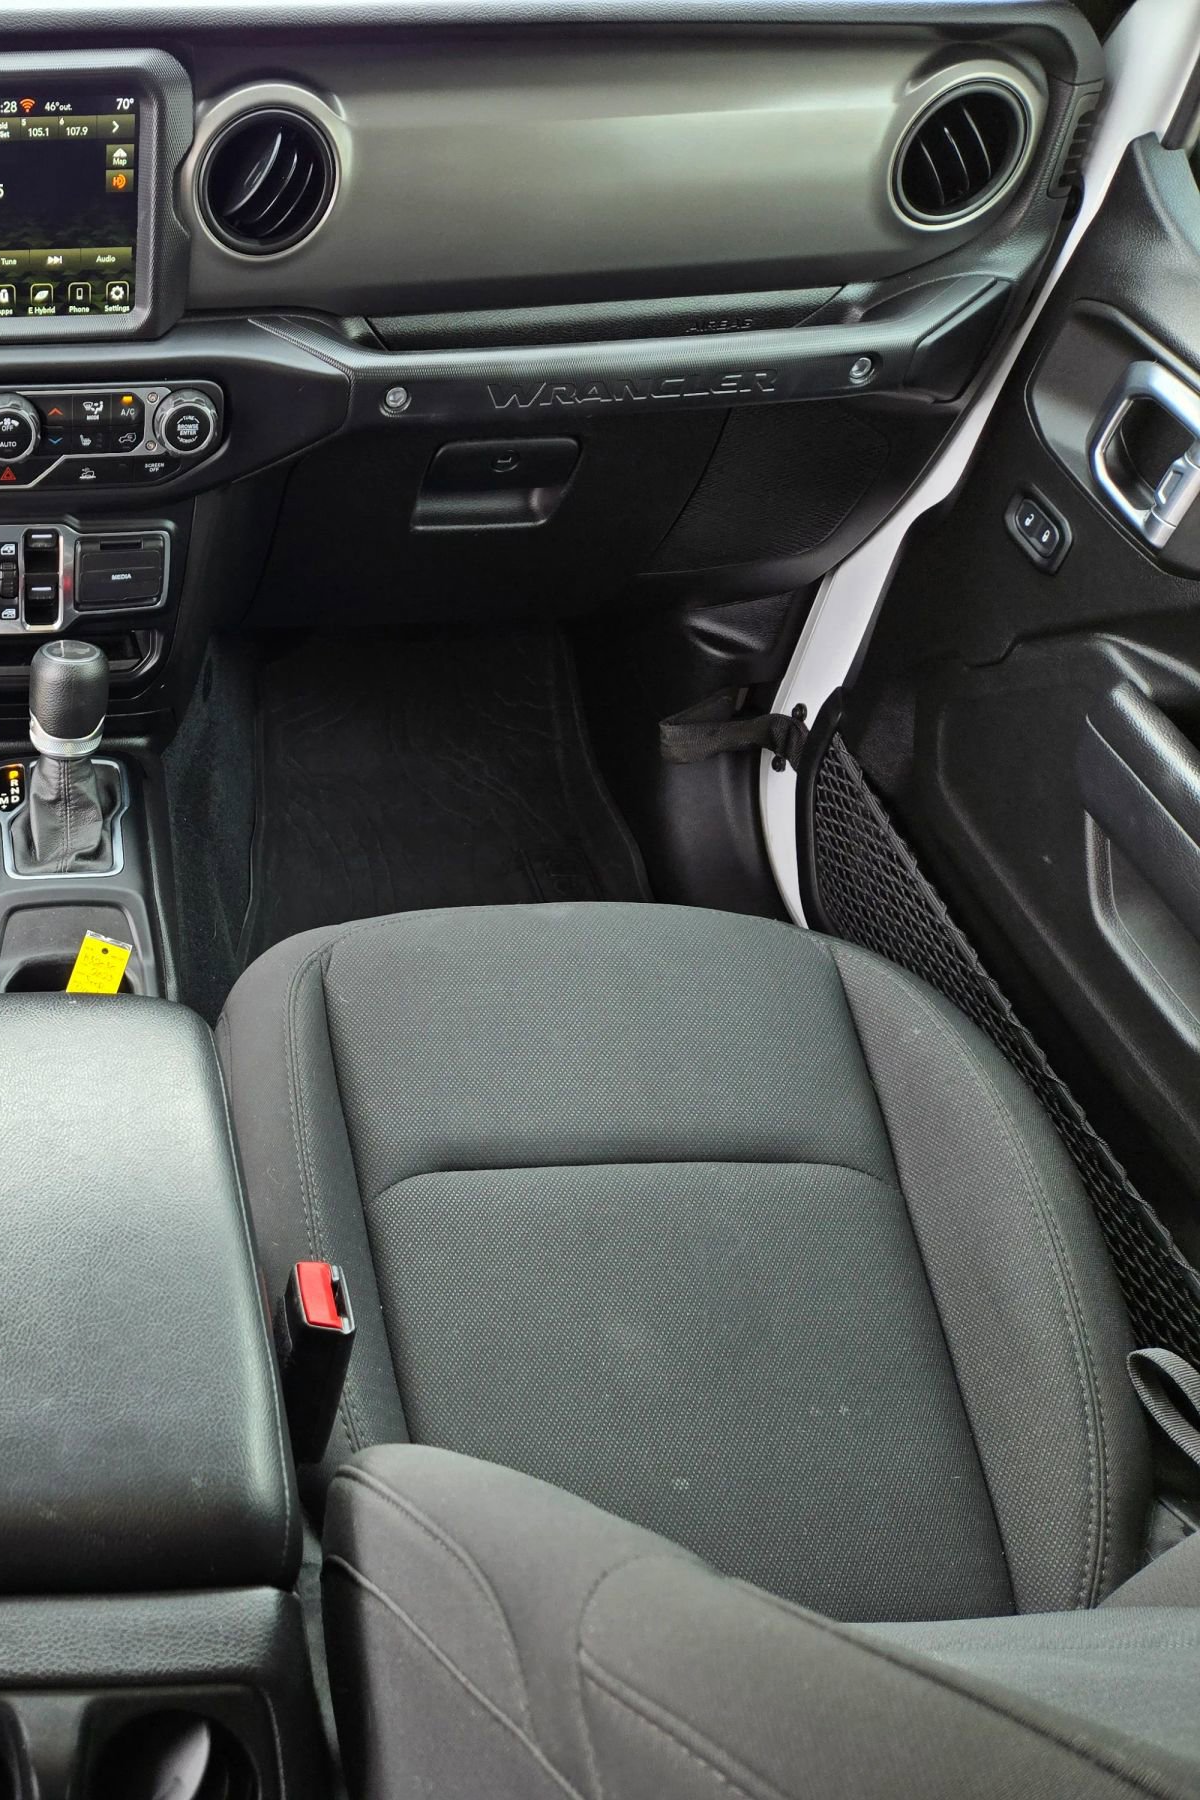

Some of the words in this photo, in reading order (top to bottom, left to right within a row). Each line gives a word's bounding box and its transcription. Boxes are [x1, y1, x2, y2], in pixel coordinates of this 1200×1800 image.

[28, 127, 49, 137] 105.1
[66, 126, 89, 136] 107.9
[113, 157, 127, 166] Map
[1, 258, 17, 266] Tune
[96, 255, 116, 264] Audio
[69, 305, 90, 313] Phone
[104, 304, 130, 314] Settings
[487, 369, 777, 409] WRANGLER
[120, 408, 135, 416] A/C
[112, 573, 132, 581] MEDIA
[9, 770, 19, 779] P
[10, 779, 19, 787] R
[10, 786, 20, 795] N
[0, 796, 9, 805] M
[11, 795, 20, 803] D
